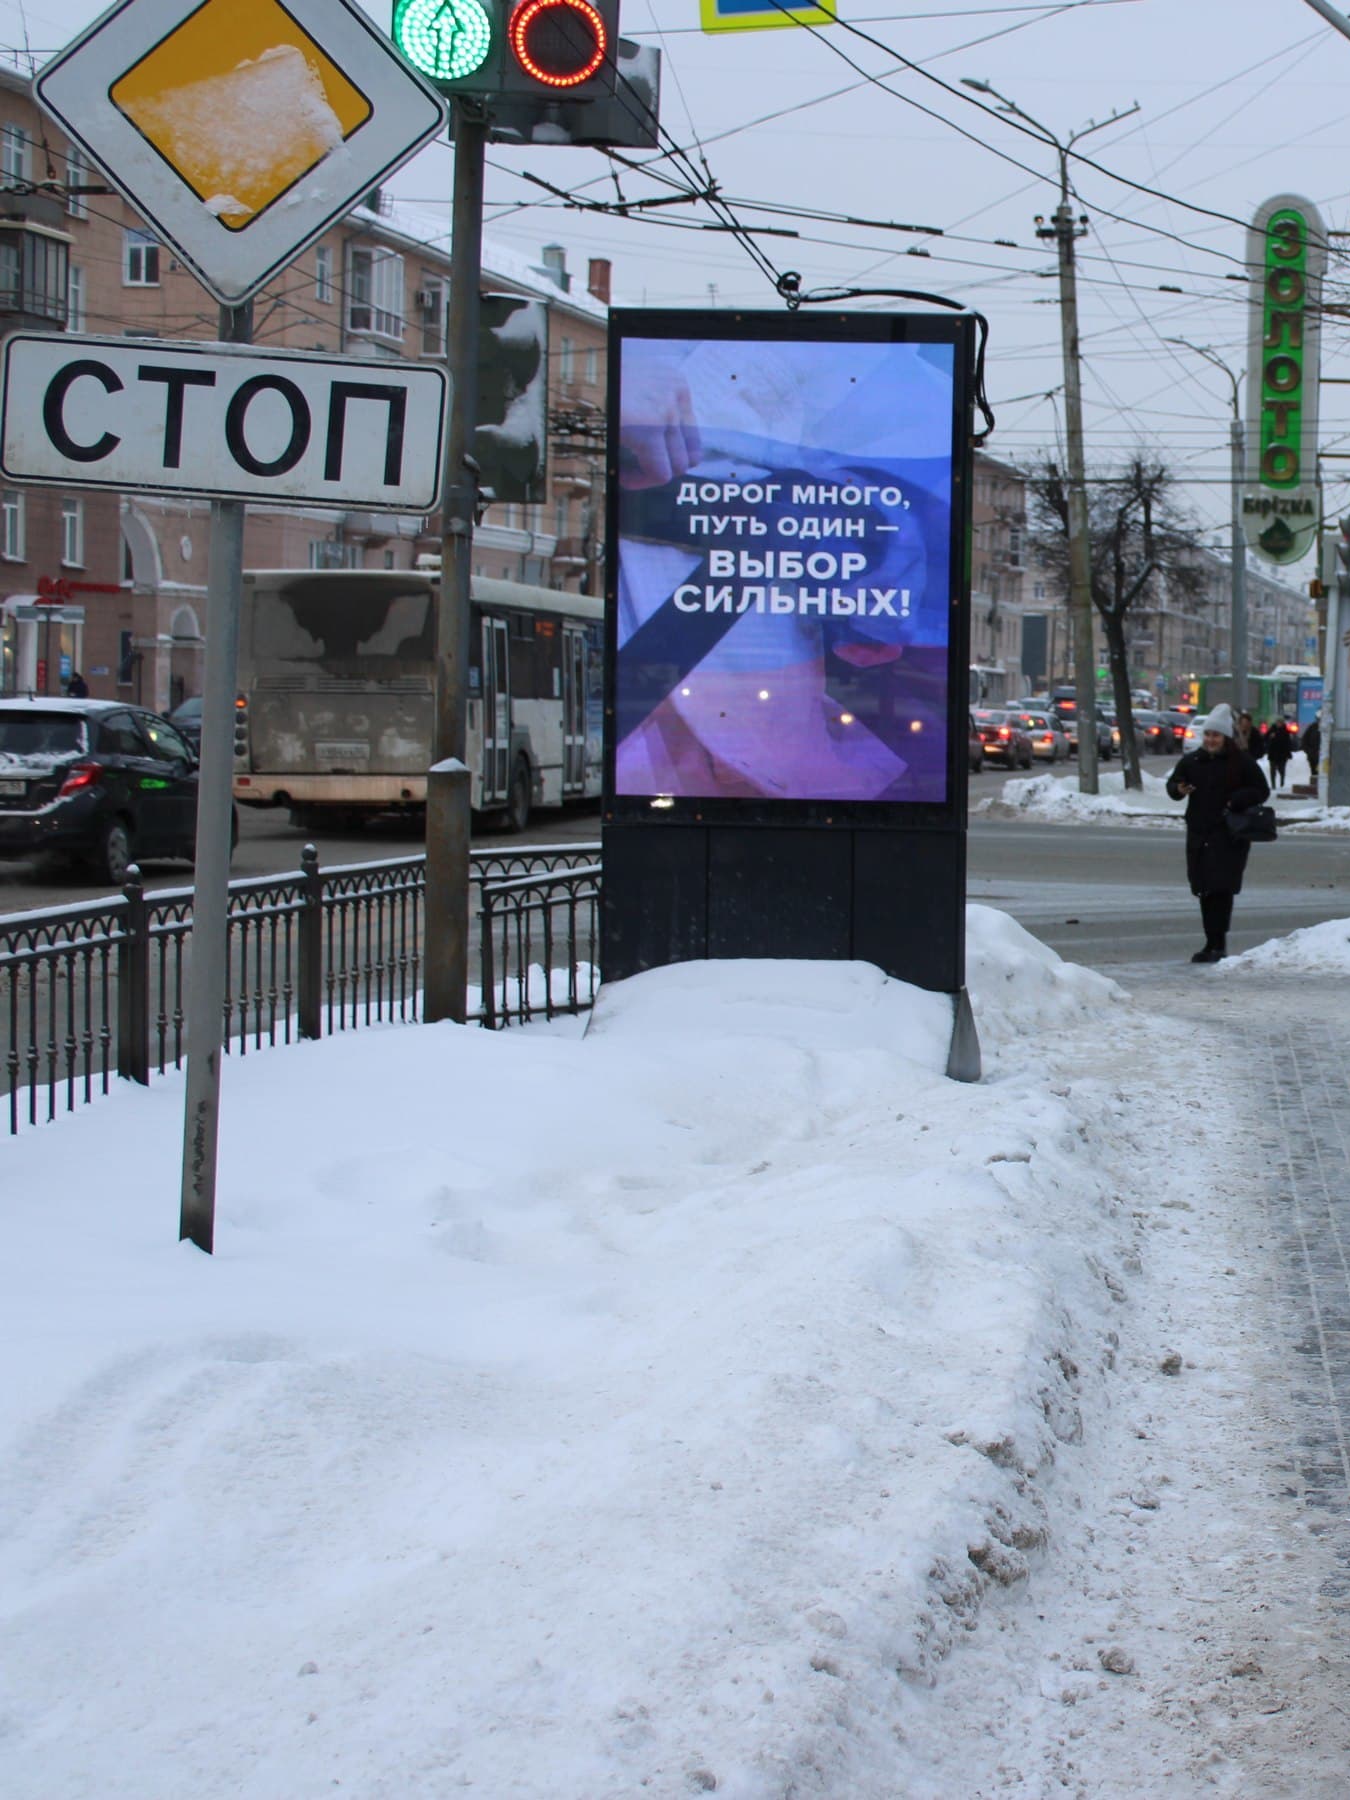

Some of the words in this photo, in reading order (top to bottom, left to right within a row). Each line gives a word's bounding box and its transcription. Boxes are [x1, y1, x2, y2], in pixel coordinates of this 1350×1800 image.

[1261, 216, 1306, 482] ЗОЛОТО
[42, 359, 408, 487] СТОП
[677, 482, 782, 507] ДОРОГ
[792, 485, 911, 511] МНОГО,
[688, 514, 768, 536] ПУТЬ
[778, 516, 866, 540] ОДИН
[709, 549, 867, 581] ВЫБОР
[673, 584, 911, 618] СИЛЬНЫХ!
